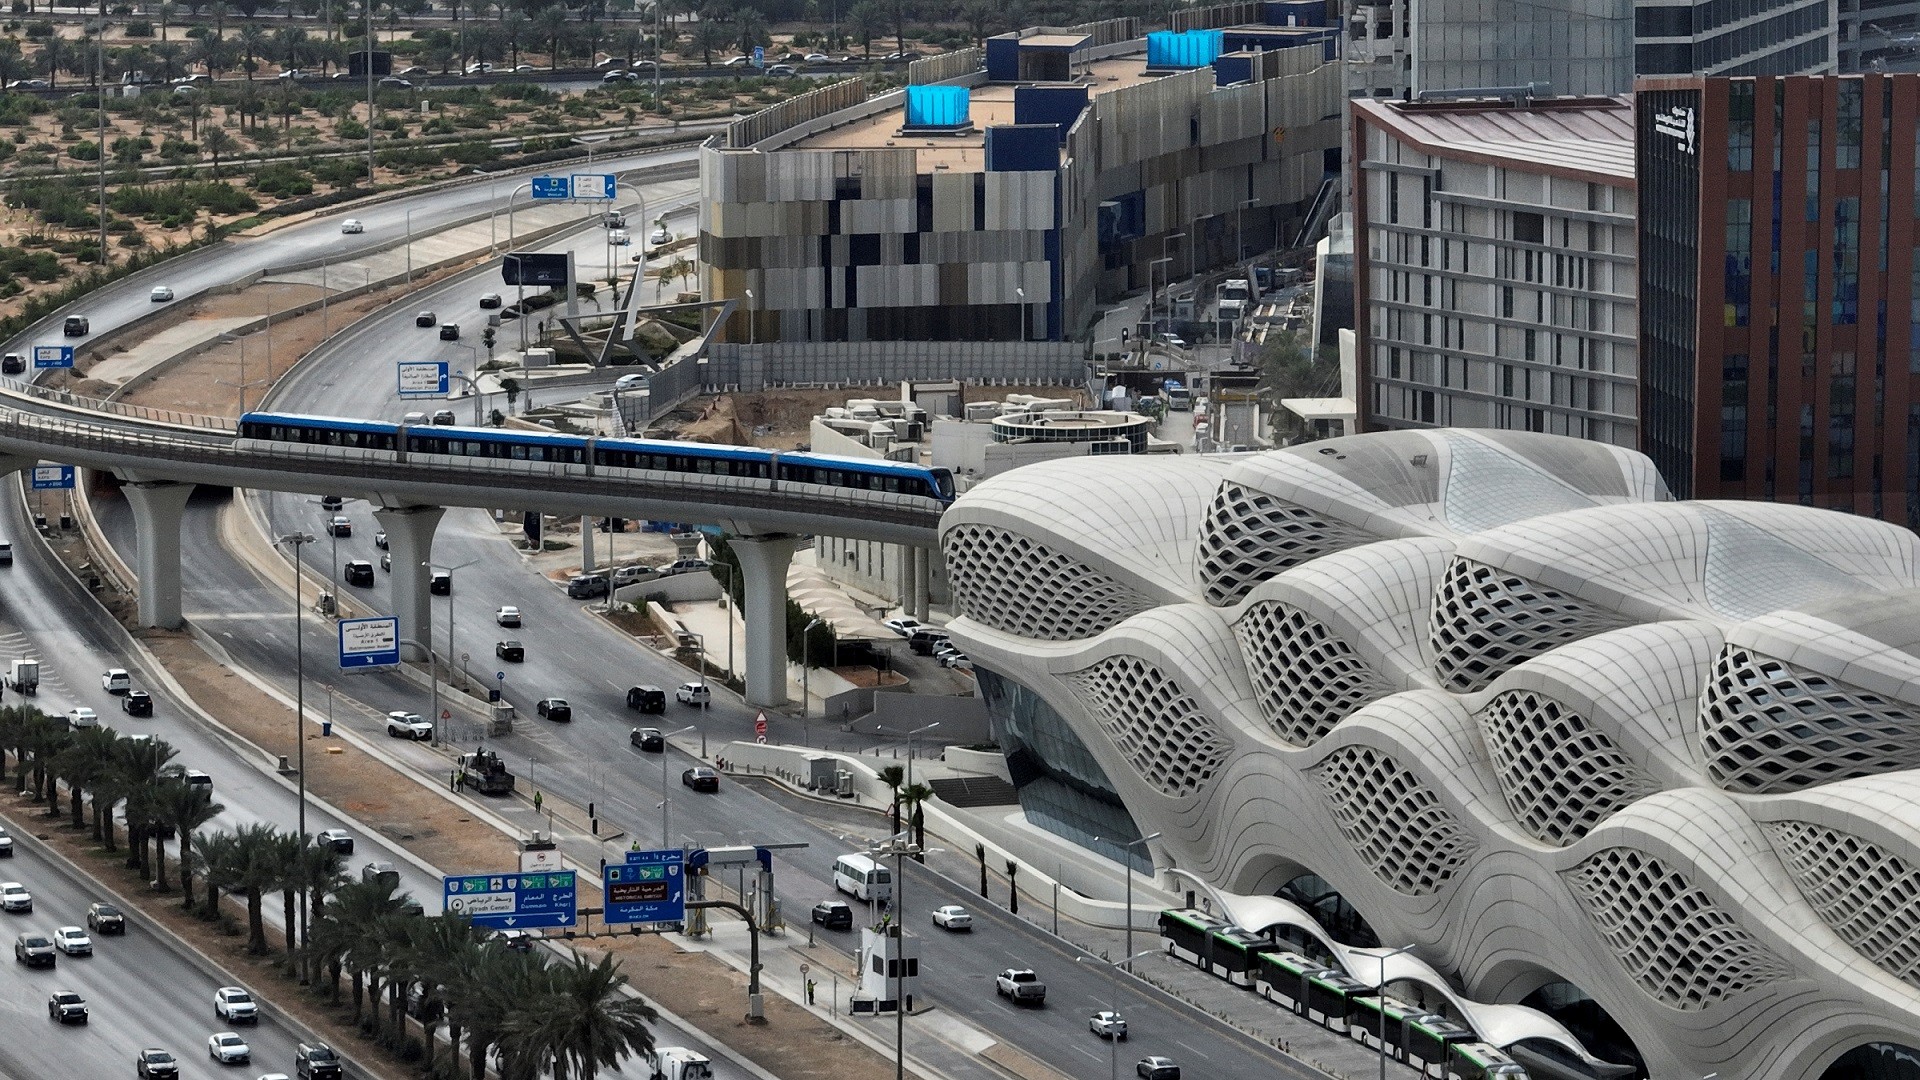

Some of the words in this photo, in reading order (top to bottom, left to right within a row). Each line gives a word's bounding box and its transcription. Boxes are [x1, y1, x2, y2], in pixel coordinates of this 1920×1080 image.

[346, 623, 368, 632] الأولى
[662, 853, 680, 861] مخرج
[613, 886, 640, 894] التاريخية
[467, 896, 492, 905] الرياض
[524, 894, 545, 902] الدمام
[552, 892, 573, 901] الخرج
